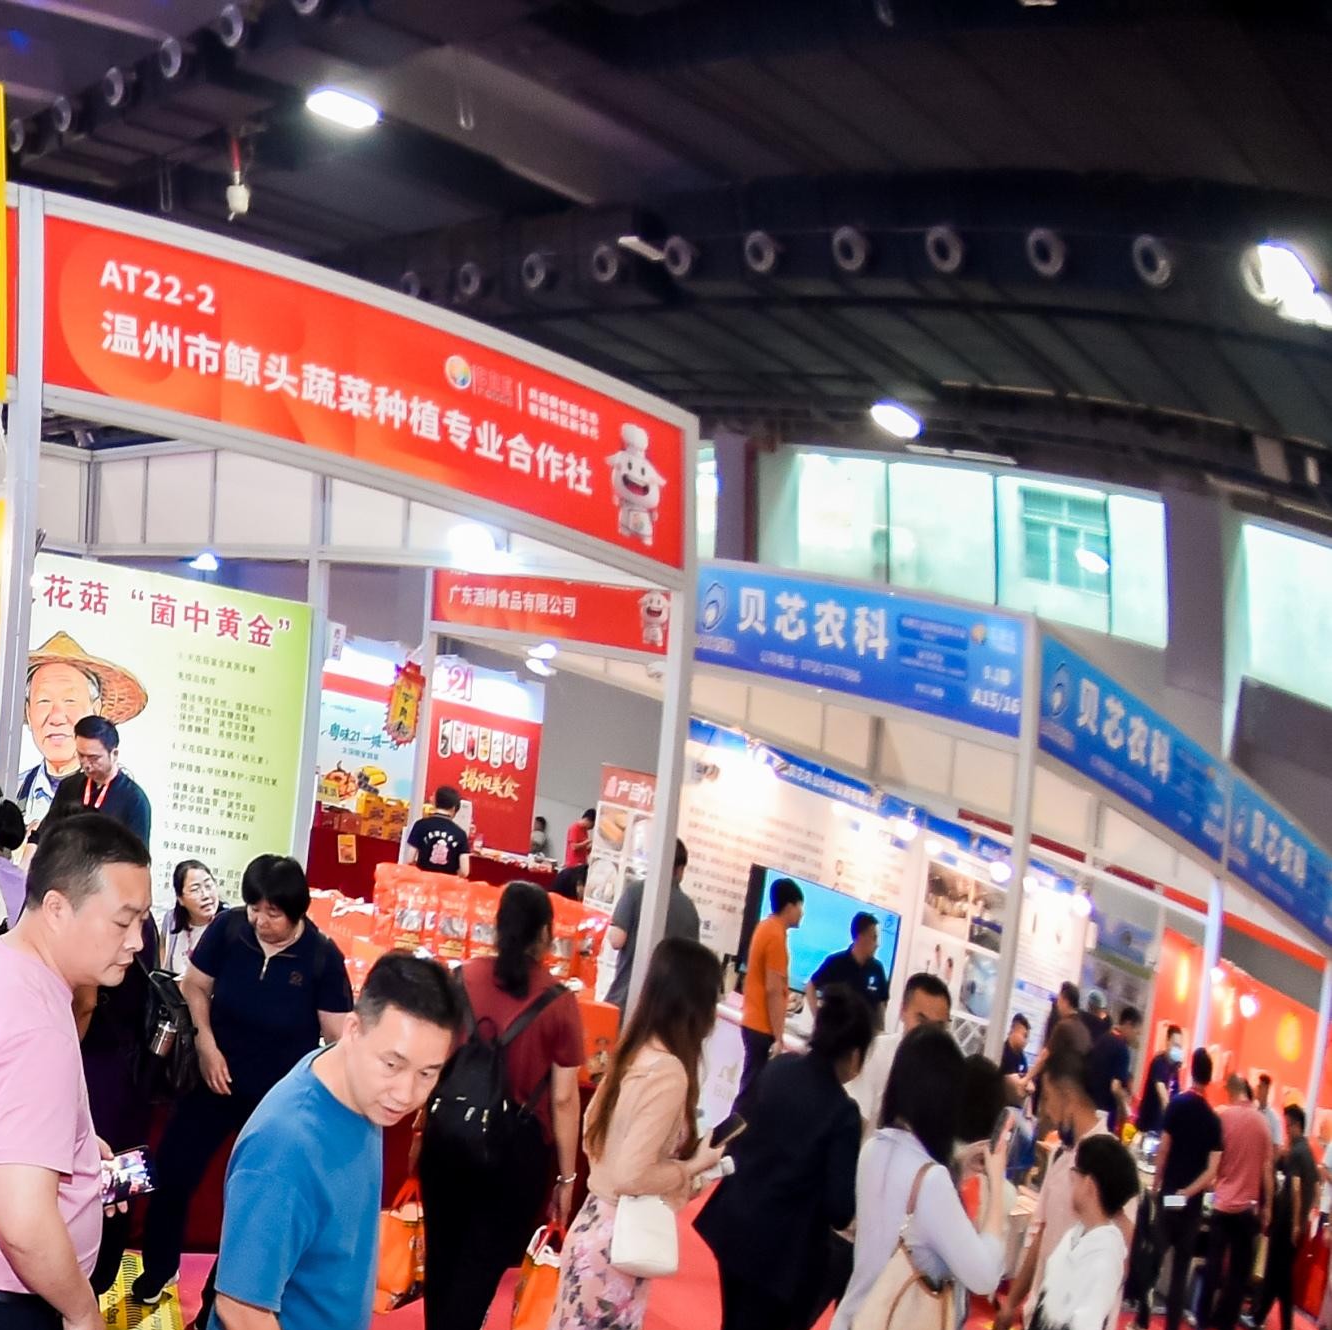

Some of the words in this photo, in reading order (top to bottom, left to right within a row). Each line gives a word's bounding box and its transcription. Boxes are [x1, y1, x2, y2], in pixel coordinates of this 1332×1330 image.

[100, 260, 216, 315] AT22-2
[101, 309, 593, 496] 温州市鲸头蔬菜种植专业合作社
[42, 574, 110, 616] 花菇
[131, 589, 291, 647] “菌中黄金”
[738, 586, 889, 661] 贝芯农科
